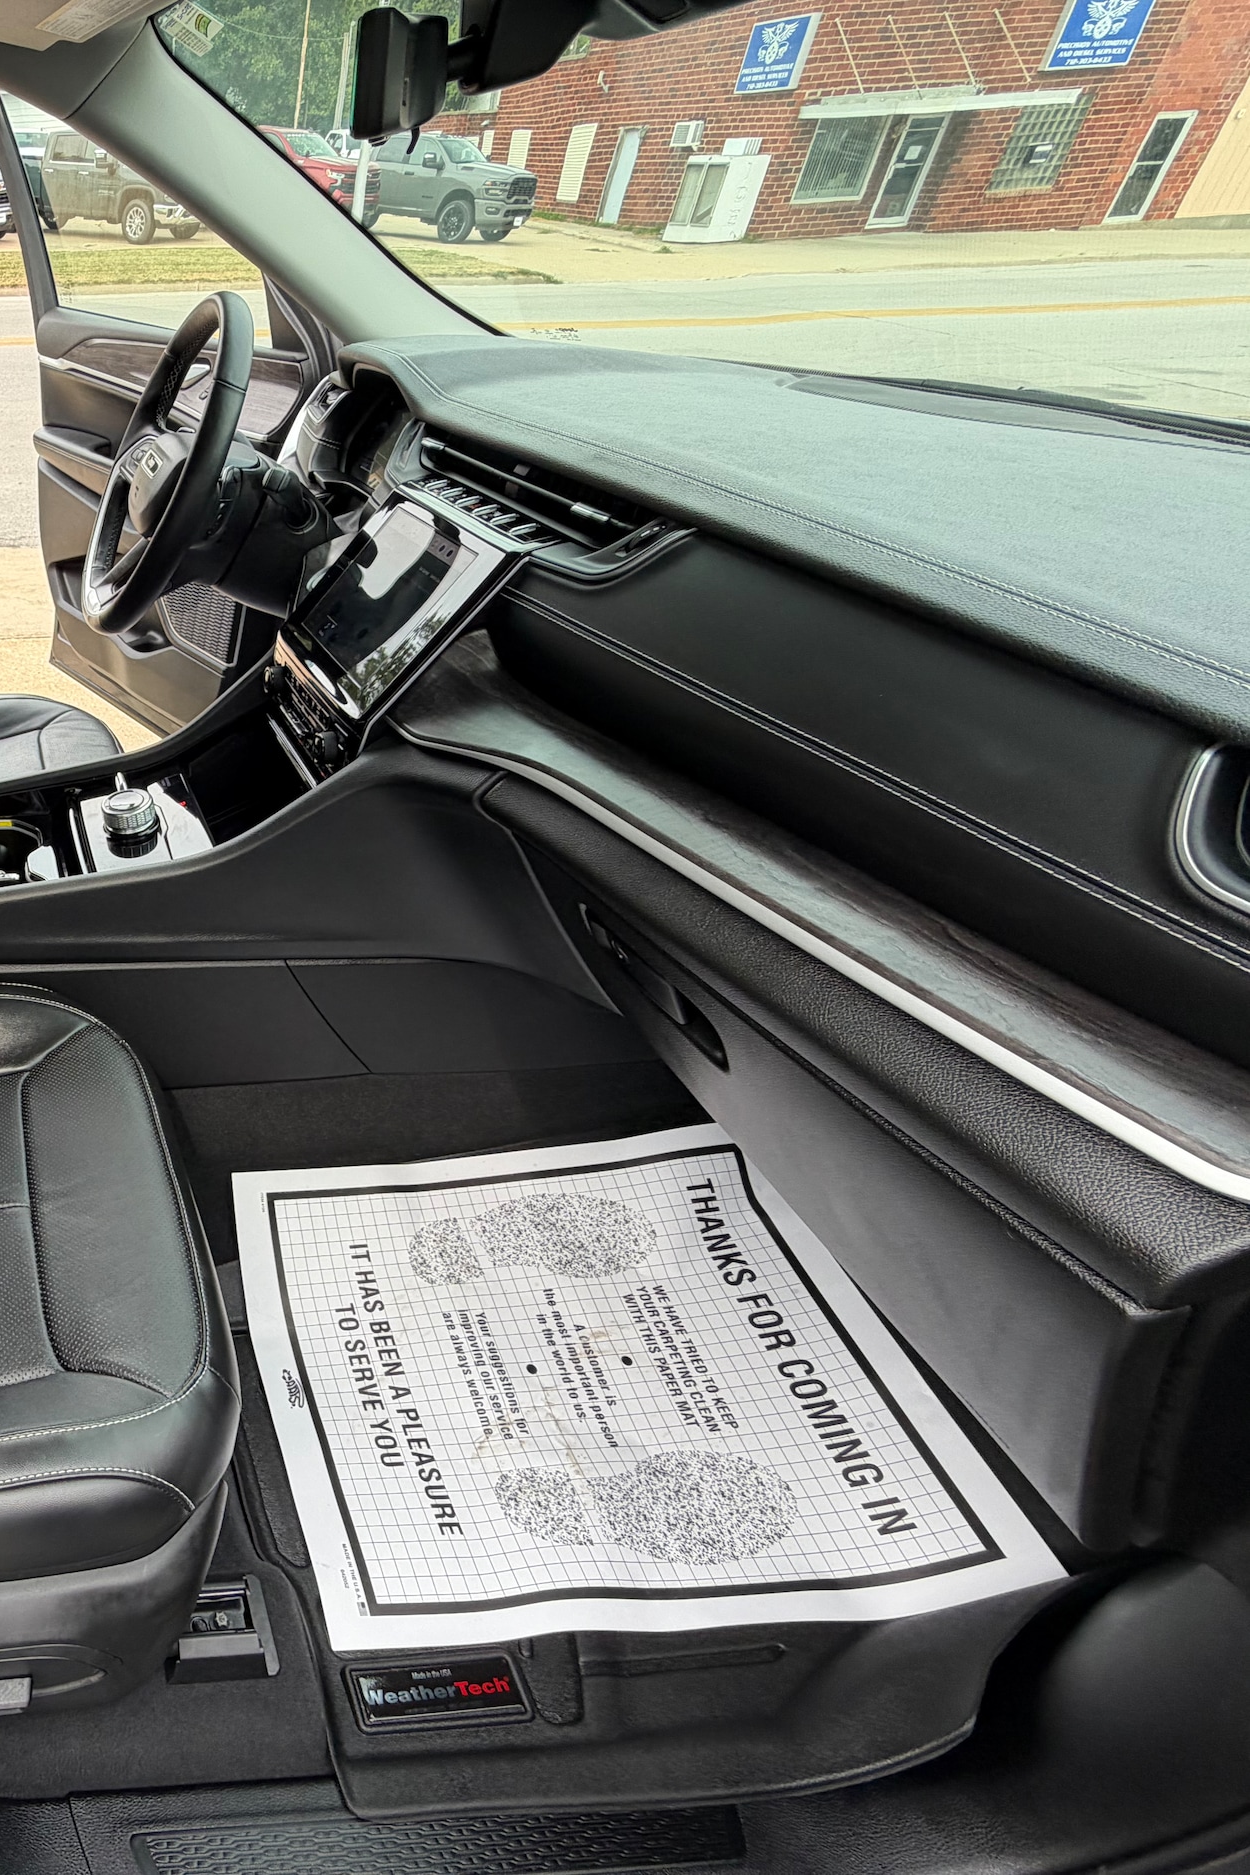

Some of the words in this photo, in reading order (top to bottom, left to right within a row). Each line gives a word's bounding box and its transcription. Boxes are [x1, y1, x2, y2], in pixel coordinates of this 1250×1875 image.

[1057, 41, 1091, 49] PRECISION
[1091, 38, 1134, 47] AUTOMOTIVE
[1072, 49, 1094, 57] DIESEL
[1095, 47, 1127, 56] SERVICES
[349, 1243, 371, 1262] IT
[334, 1303, 360, 1331] TO
[354, 1271, 385, 1313] HAS
[369, 1320, 406, 1377] BEEN
[442, 1312, 456, 1330] are
[450, 1335, 472, 1375] always
[573, 1324, 586, 1332] A
[344, 1339, 385, 1411] SERVE
[458, 1309, 486, 1366] improving
[481, 1371, 495, 1391] our
[490, 1395, 514, 1440] service
[475, 1312, 492, 1337] Your
[486, 1341, 520, 1414] suggestions
[514, 1418, 529, 1435] for
[536, 1313, 547, 1324] in
[542, 1328, 556, 1346] the
[551, 1350, 574, 1383] world
[566, 1388, 579, 1399] to
[573, 1404, 586, 1423] us.
[543, 1288, 556, 1306] the
[551, 1310, 572, 1339] most
[564, 1343, 599, 1400] important
[589, 1405, 619, 1447] person
[579, 1335, 610, 1391] customer
[622, 1293, 646, 1323] WITH
[639, 1325, 662, 1354] THIS
[653, 1357, 683, 1397] PAPER
[675, 1401, 700, 1427] MAT
[636, 1286, 660, 1317] YOUR
[653, 1320, 697, 1388] CARPETING
[690, 1391, 721, 1433] CLEAN
[652, 1285, 671, 1304] WE
[662, 1306, 688, 1335] HAVE
[680, 1338, 708, 1374] TRIED
[702, 1377, 719, 1393] TO
[711, 1397, 739, 1429] KEEP
[686, 1178, 757, 1286] THANKS
[736, 1293, 796, 1351] FOR
[777, 1359, 884, 1488] COMING
[861, 1496, 918, 1536] IN
[388, 1385, 411, 1400] A
[605, 1395, 617, 1406] is
[370, 1418, 405, 1467] YOU
[396, 1408, 464, 1535] PLEASURE
[342, 1543, 351, 1560] MADE
[349, 1569, 357, 1580] THE
[411, 1671, 426, 1680] Made
[440, 1669, 452, 1677] USA
